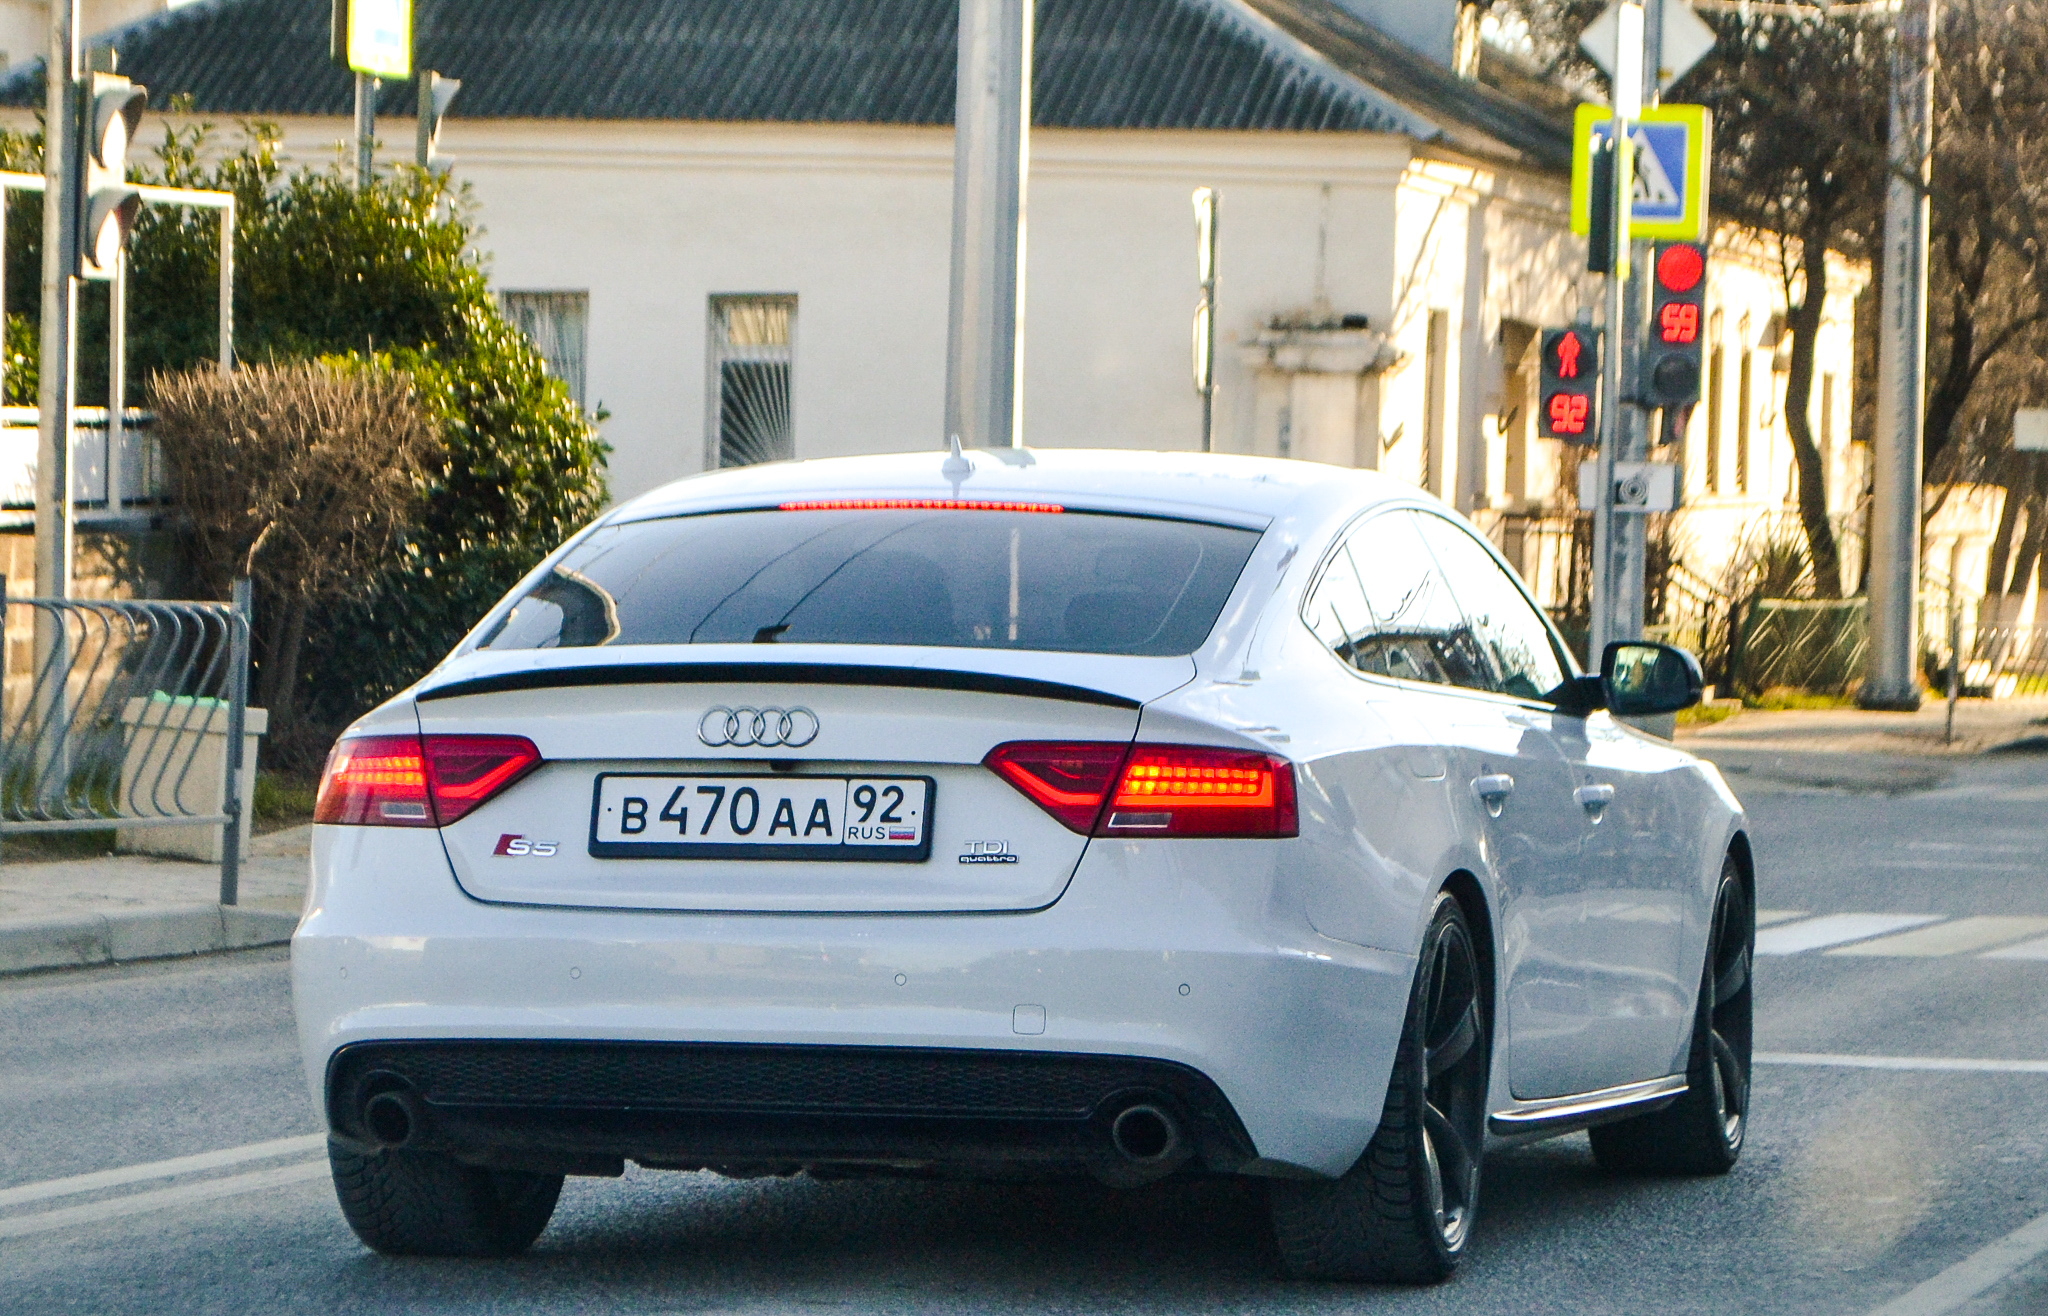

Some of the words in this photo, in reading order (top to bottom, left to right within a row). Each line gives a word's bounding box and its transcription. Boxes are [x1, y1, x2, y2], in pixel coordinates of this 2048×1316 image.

[1661, 303, 1699, 343] 59
[1550, 393, 1589, 434] 92
[853, 784, 905, 823] 92
[848, 826, 885, 840] RUS
[506, 838, 560, 857] S5
[964, 840, 1009, 855] TDI
[960, 855, 1017, 864] quattro
